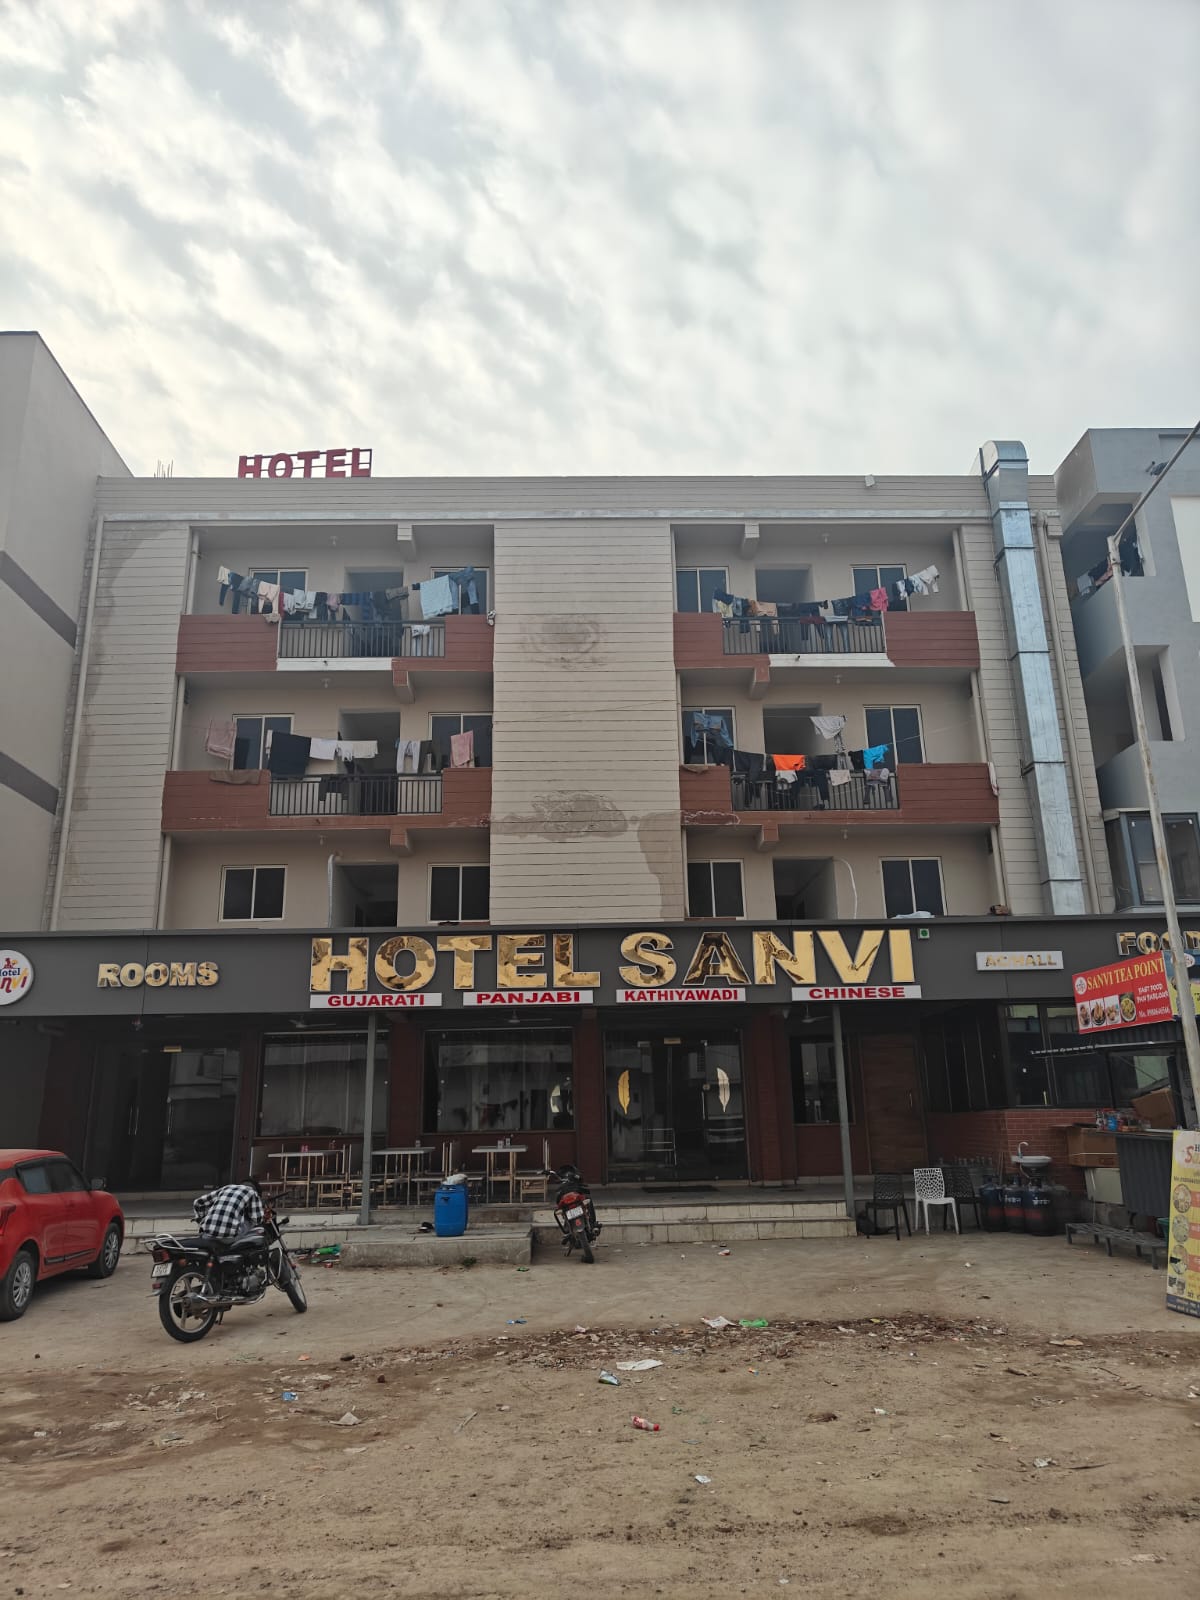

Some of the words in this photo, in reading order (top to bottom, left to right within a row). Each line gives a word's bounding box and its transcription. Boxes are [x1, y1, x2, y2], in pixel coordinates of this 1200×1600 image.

[238, 448, 371, 478] HOTEL
[309, 933, 601, 991] HOTEL
[618, 929, 915, 986] SANVI
[0, 968, 28, 993] nvi
[97, 961, 220, 987] ROOMS
[1087, 971, 1112, 990] SANVI
[1113, 966, 1134, 984] TEA
[1134, 958, 1164, 979] POINT
[327, 994, 425, 1007] GUJARATI
[476, 991, 580, 1004] PANJABI
[624, 988, 738, 1001] KATHIYAWADI
[808, 986, 906, 998] CHINESE
